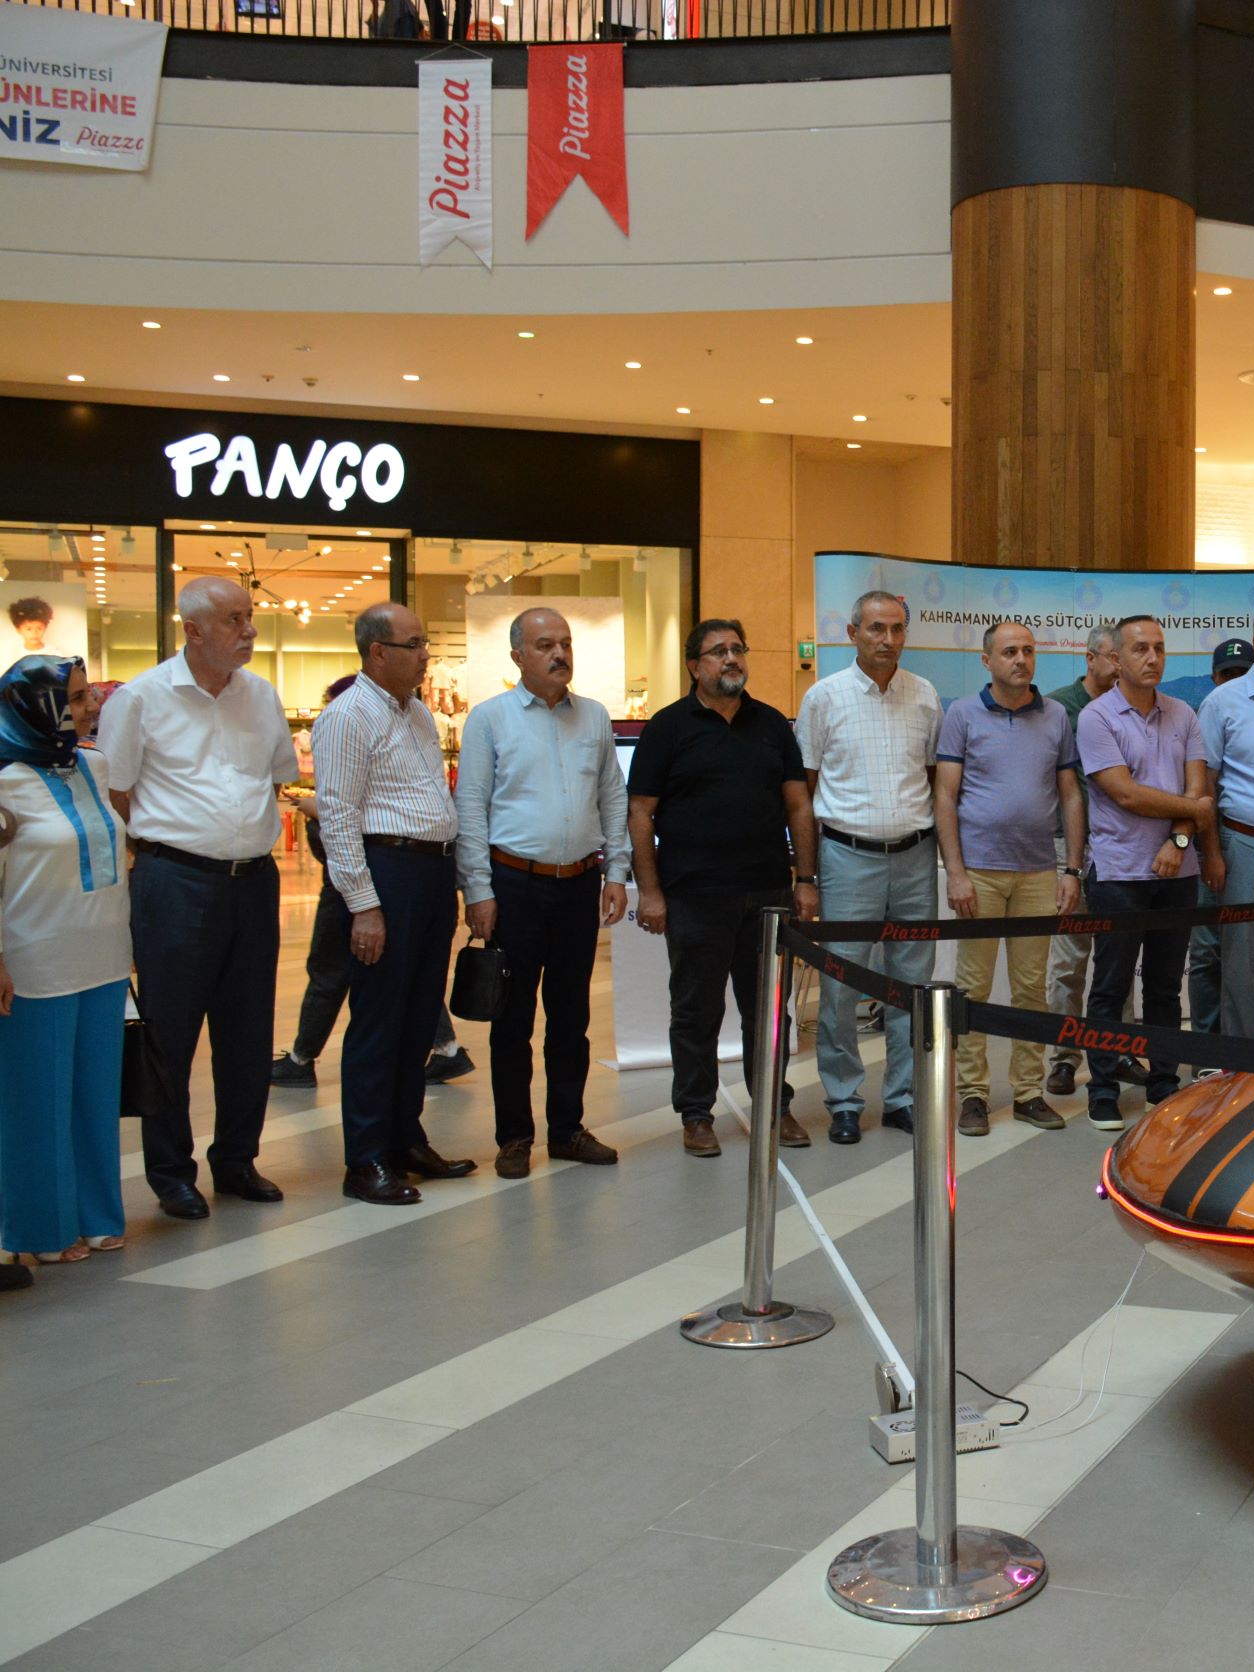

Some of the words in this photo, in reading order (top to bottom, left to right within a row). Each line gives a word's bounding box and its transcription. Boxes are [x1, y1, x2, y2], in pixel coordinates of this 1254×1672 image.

[559, 54, 591, 160] Piazza
[428, 78, 470, 219] Piazza
[164, 433, 405, 511] PANÇO
[1046, 612, 1094, 630] SÜTÇÜ
[1156, 613, 1250, 629] NİVERSİTESİ
[880, 922, 941, 941] Piazza
[1057, 917, 1113, 933] Piazza
[1057, 1015, 1149, 1056] Piazza
